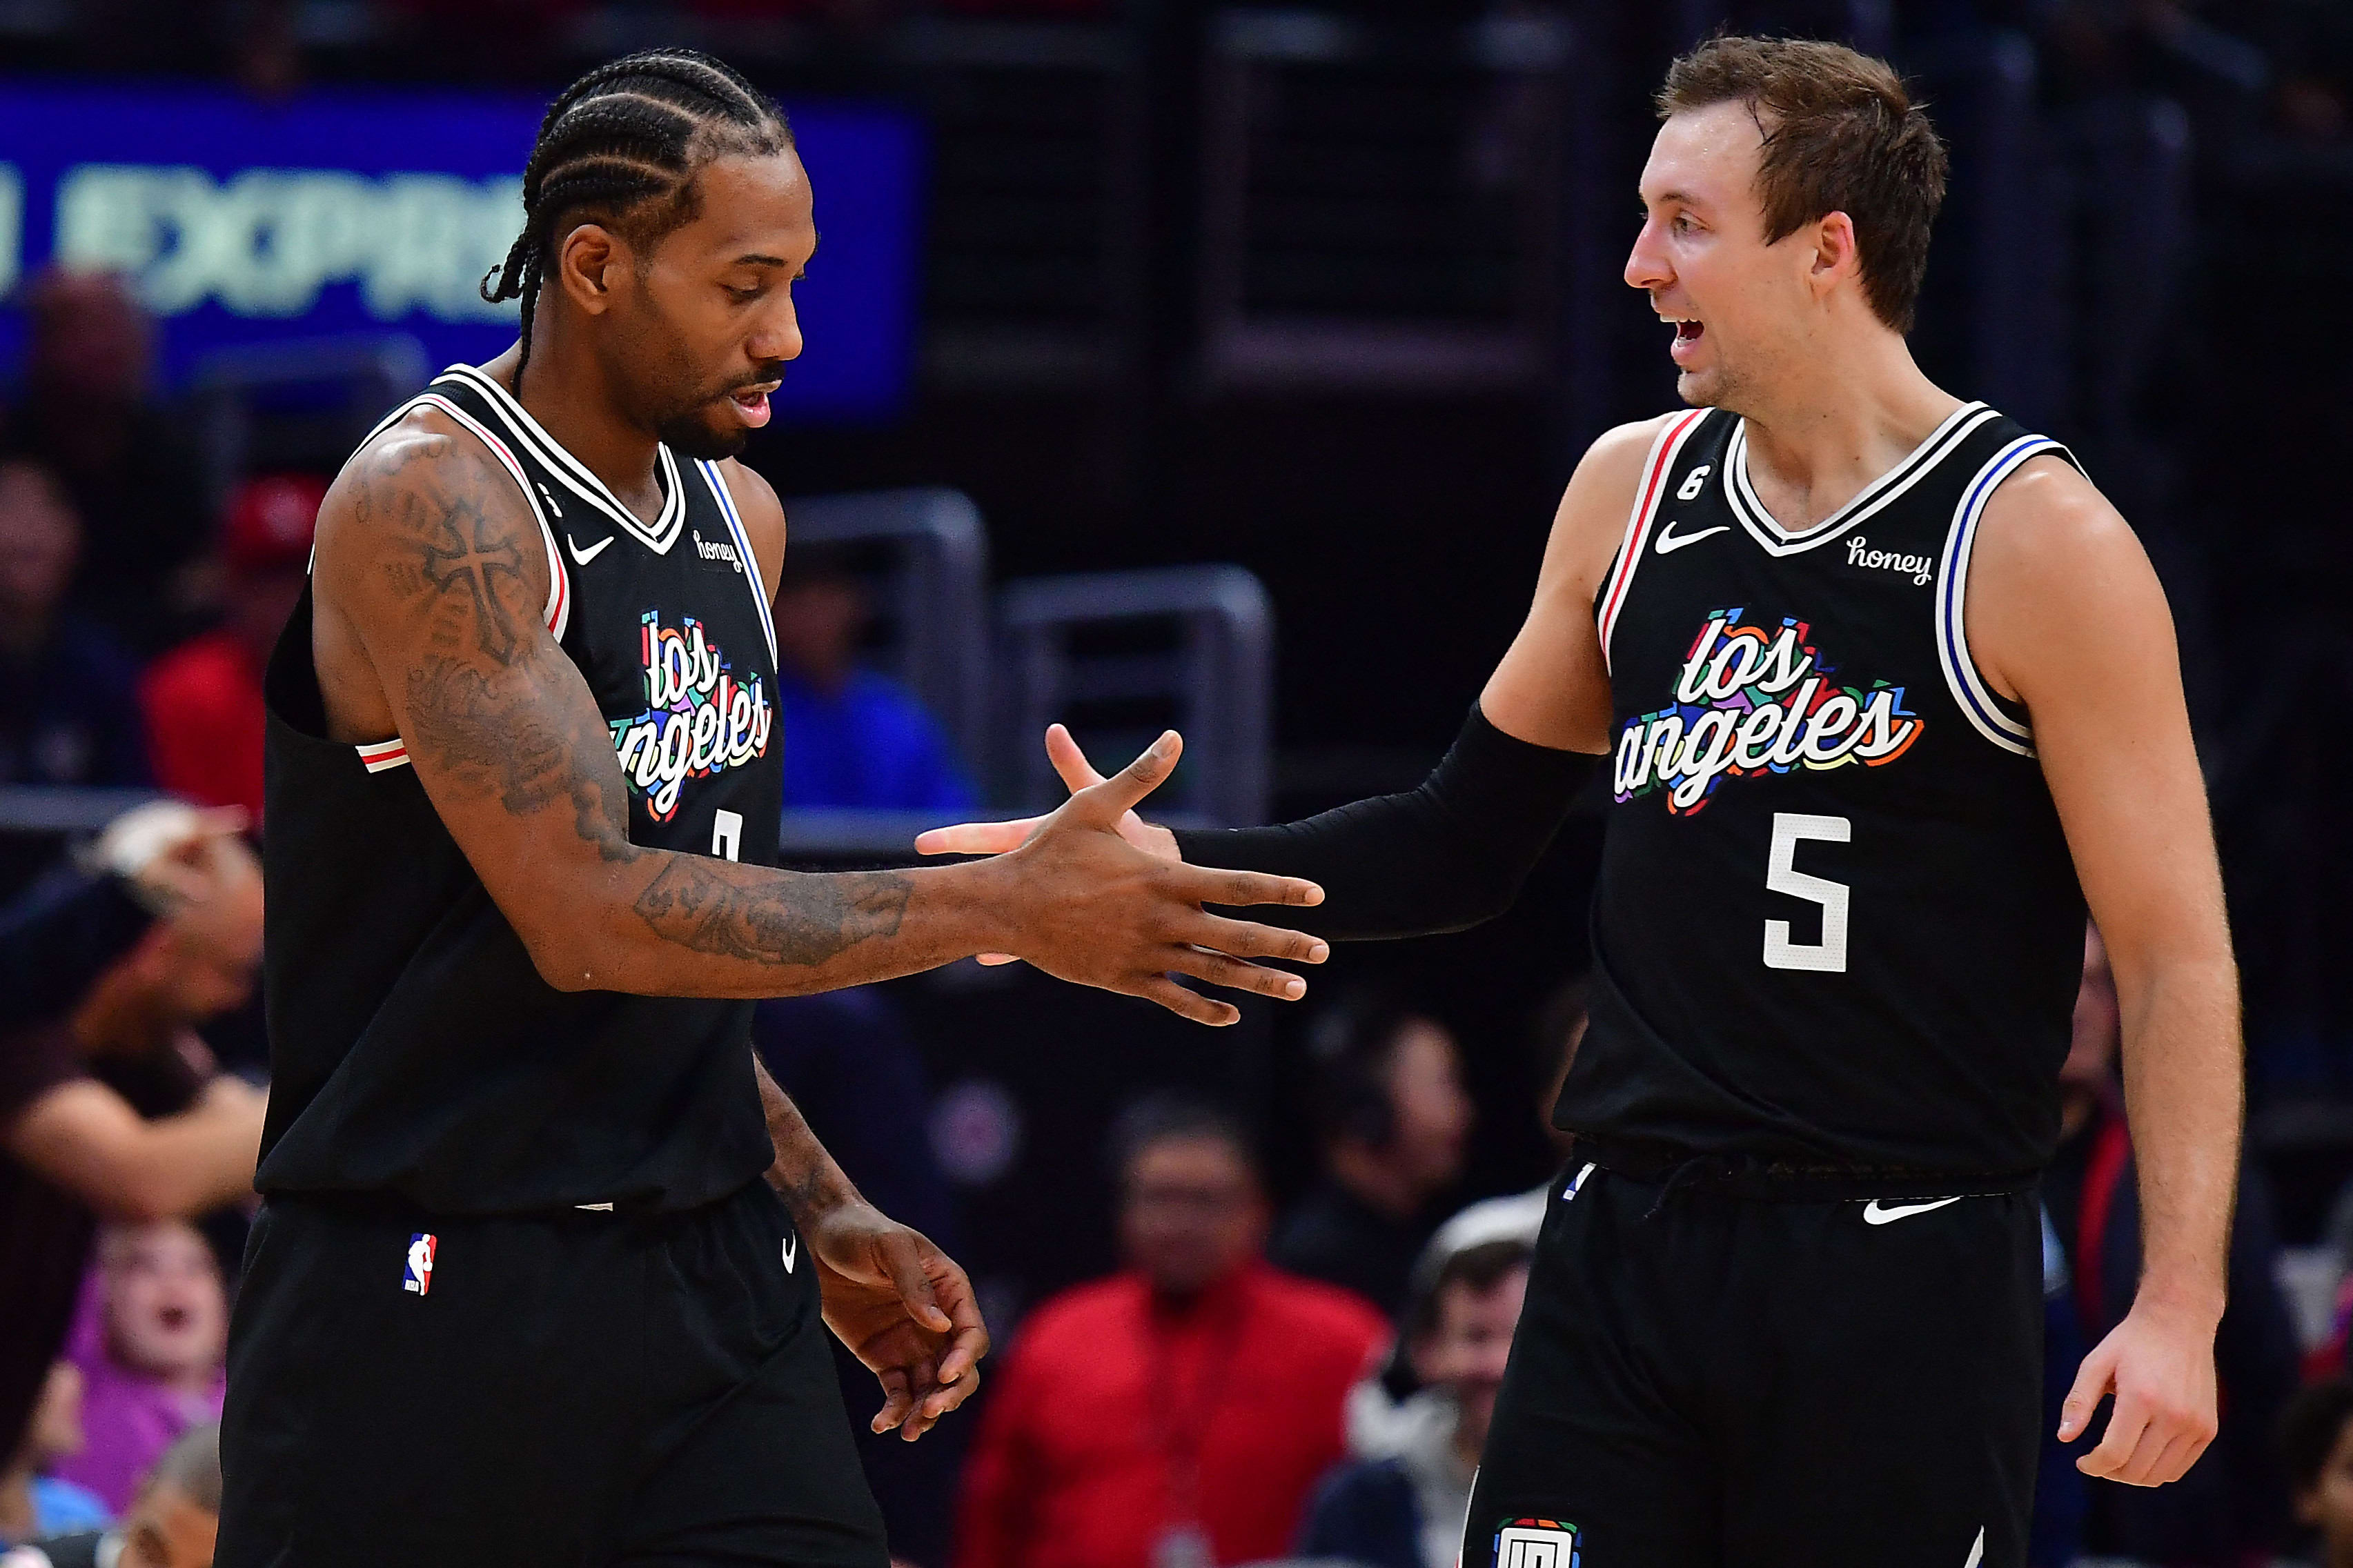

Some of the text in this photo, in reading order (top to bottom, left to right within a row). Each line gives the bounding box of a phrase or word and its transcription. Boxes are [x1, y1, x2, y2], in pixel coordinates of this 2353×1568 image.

[1677, 465, 1711, 500] 6
[693, 530, 742, 573] honey
[1847, 536, 1932, 586] honey
[645, 622, 718, 709] los
[1677, 617, 1814, 702] los
[610, 675, 771, 814] ngeles
[1615, 679, 1915, 808] angeles
[1763, 812, 1851, 973] 5
